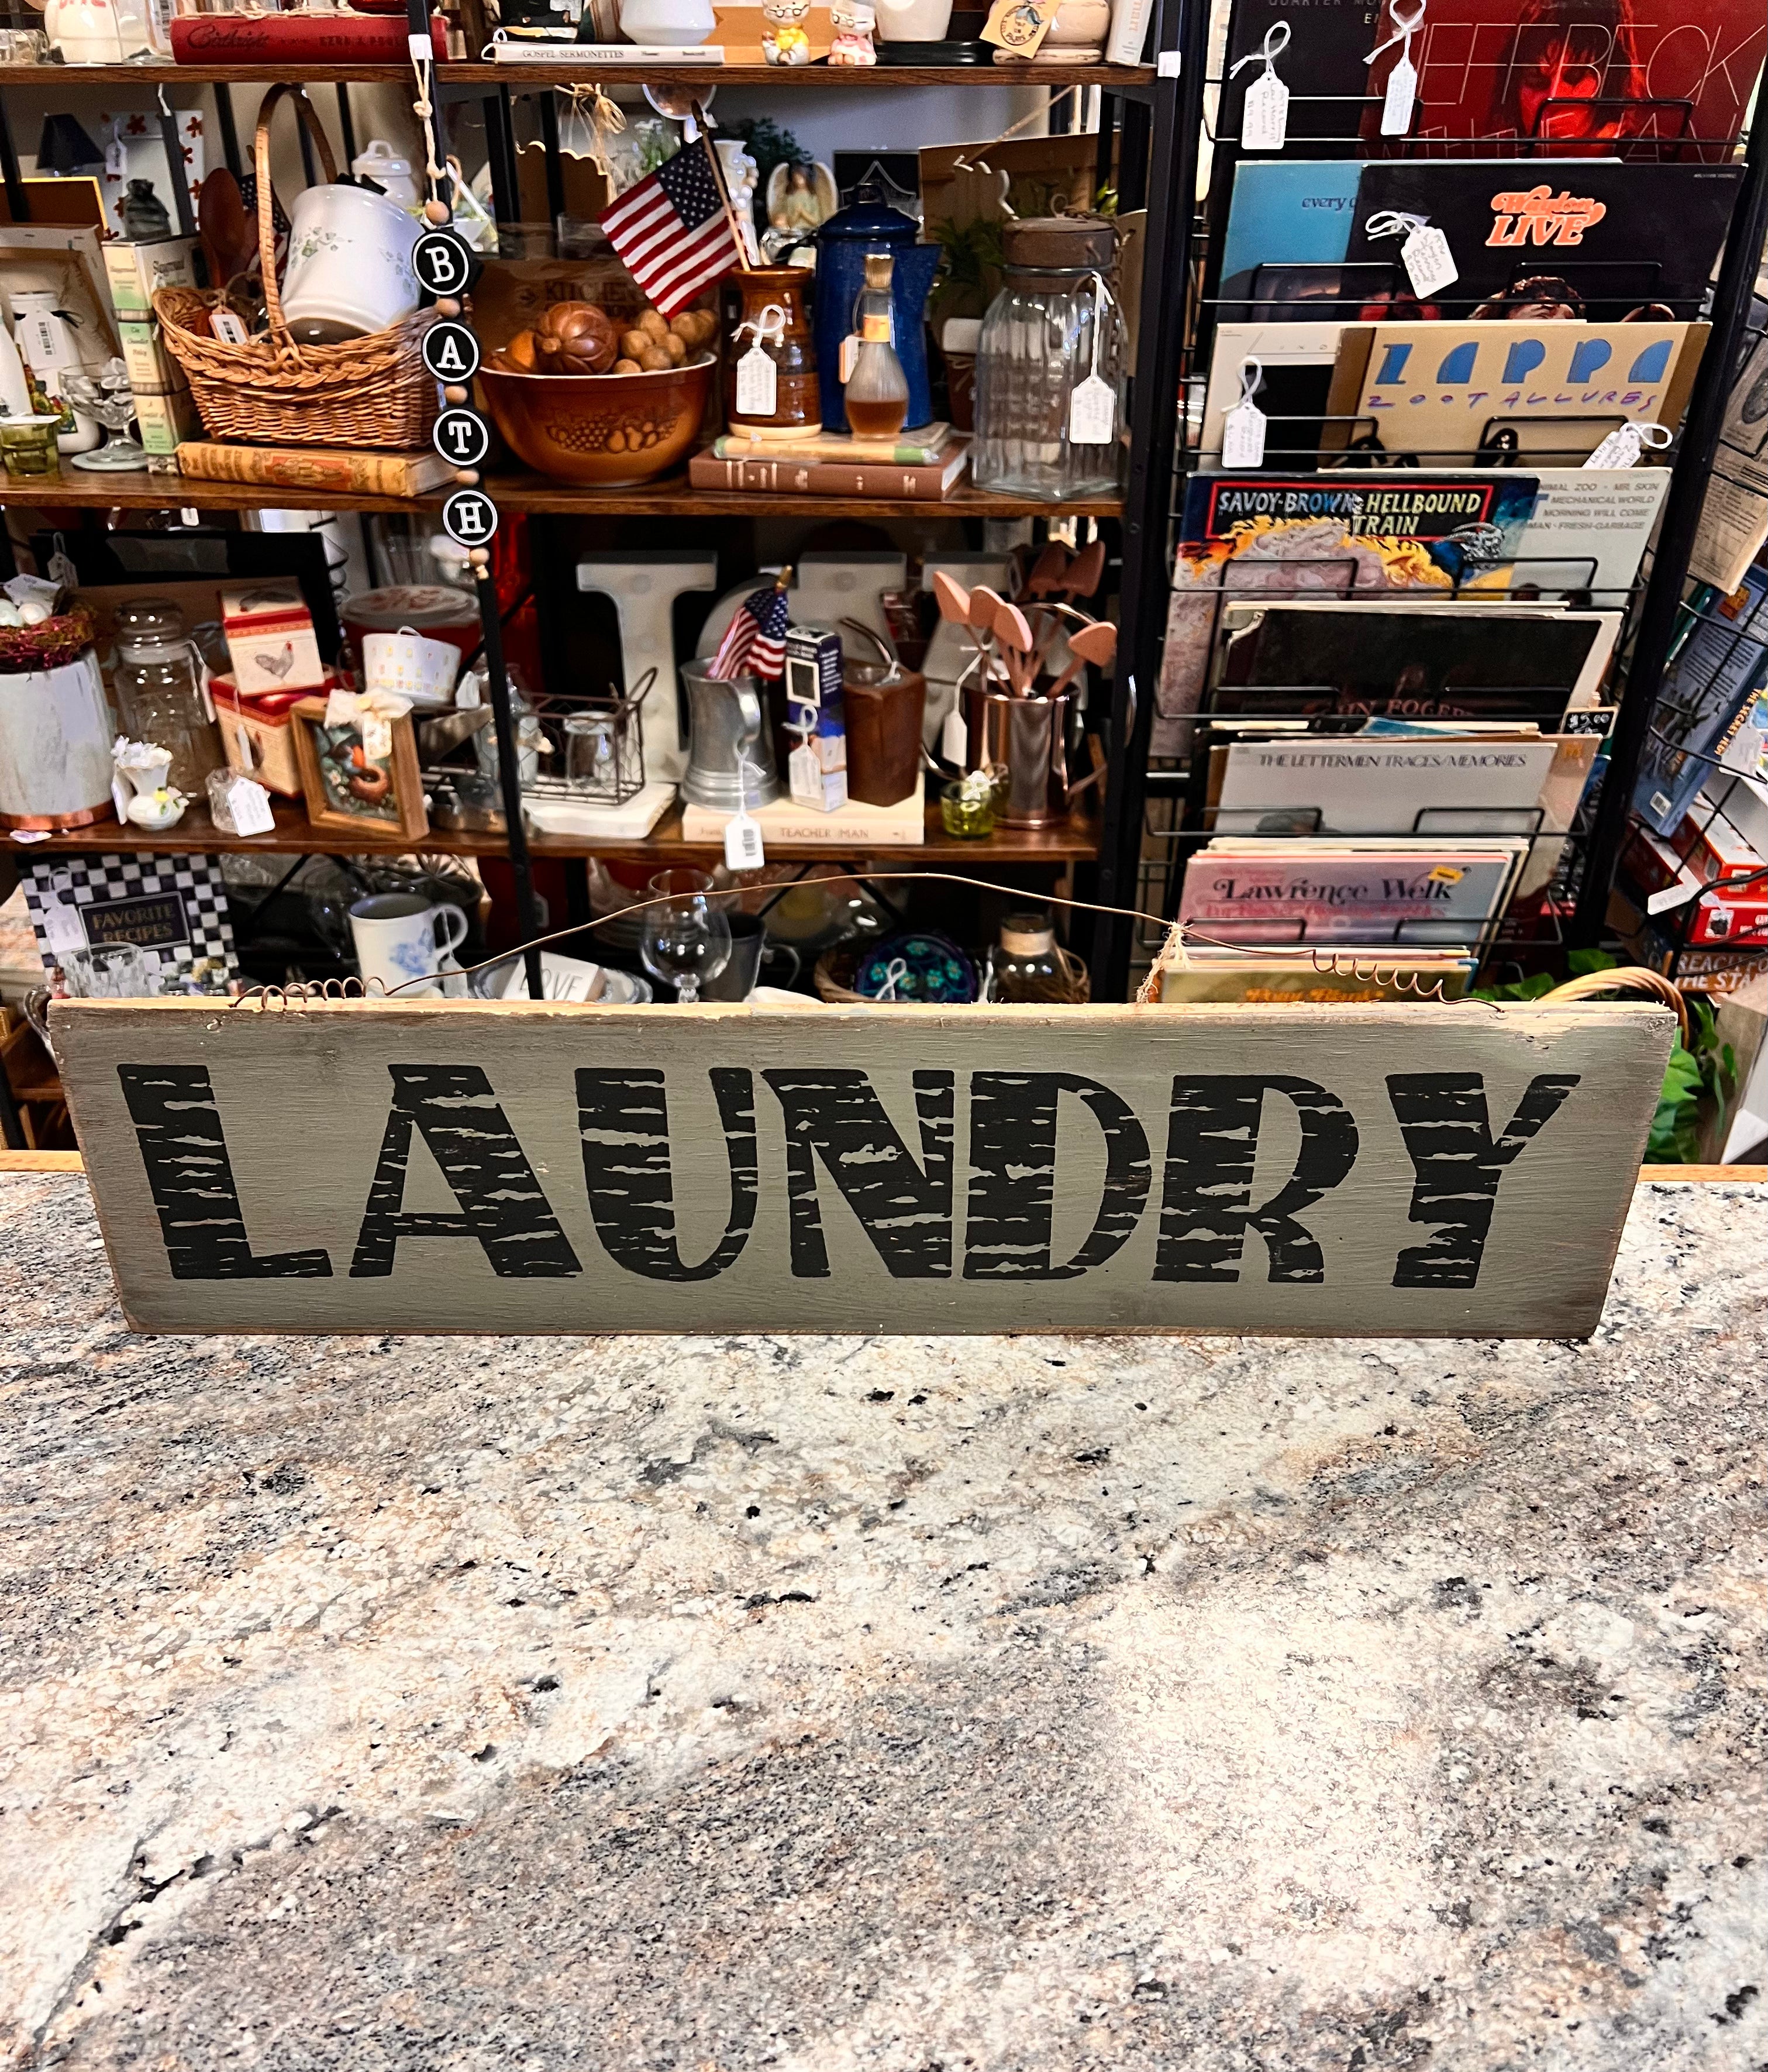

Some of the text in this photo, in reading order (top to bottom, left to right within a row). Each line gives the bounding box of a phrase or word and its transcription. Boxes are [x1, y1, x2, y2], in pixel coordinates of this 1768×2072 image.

[522, 50, 556, 58] GOSPEL
[1551, 23, 1766, 106] BECK
[1301, 197, 1346, 211] every
[1490, 185, 1607, 228] Waylon
[1485, 215, 1590, 246] LIVE
[1374, 338, 1674, 385] ZAPPA
[1501, 390, 1657, 411] ALLURES
[1366, 493, 1481, 514] HELLBOUND
[1352, 515, 1421, 536] TRAIN
[1259, 753, 1288, 767] THE
[780, 827, 831, 838] TEACHER
[840, 828, 870, 839] MAN
[1213, 870, 1452, 905] Lawrence Welk
[92, 903, 174, 931] FAVORITE
[103, 922, 173, 943] RECIPES
[118, 1063, 1581, 1288] LAUNDRY
